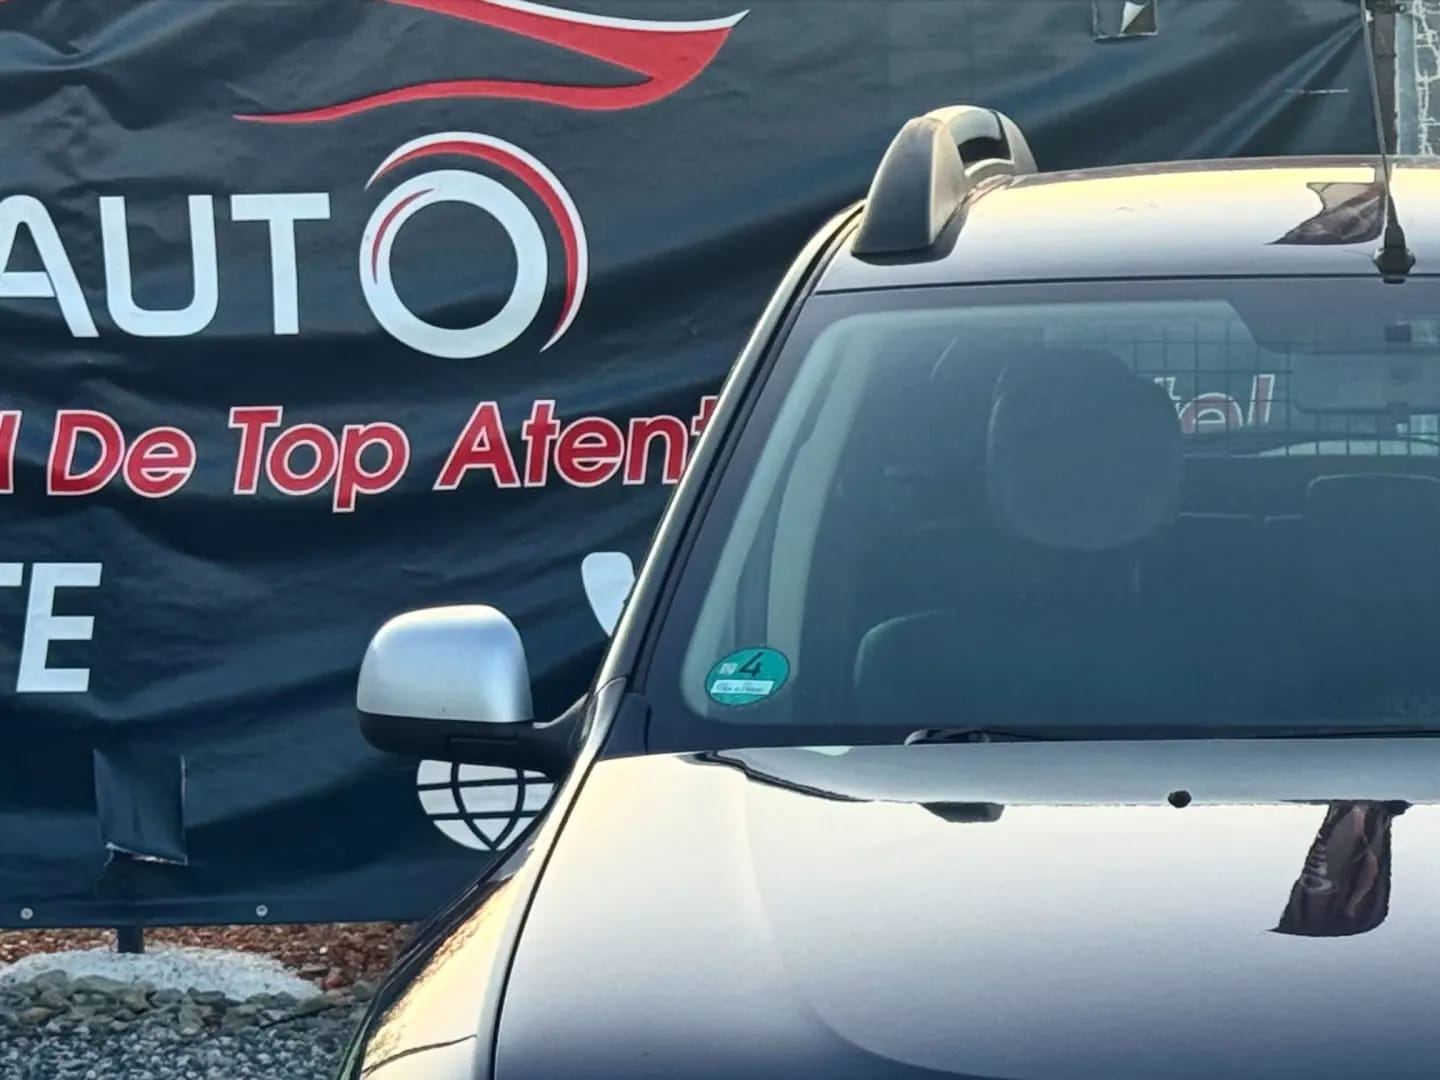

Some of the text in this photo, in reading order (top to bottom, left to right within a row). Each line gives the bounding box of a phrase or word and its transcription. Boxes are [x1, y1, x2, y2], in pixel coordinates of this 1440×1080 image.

[46, 409, 197, 499] De
[227, 404, 412, 514] Top
[740, 651, 764, 677] 4
